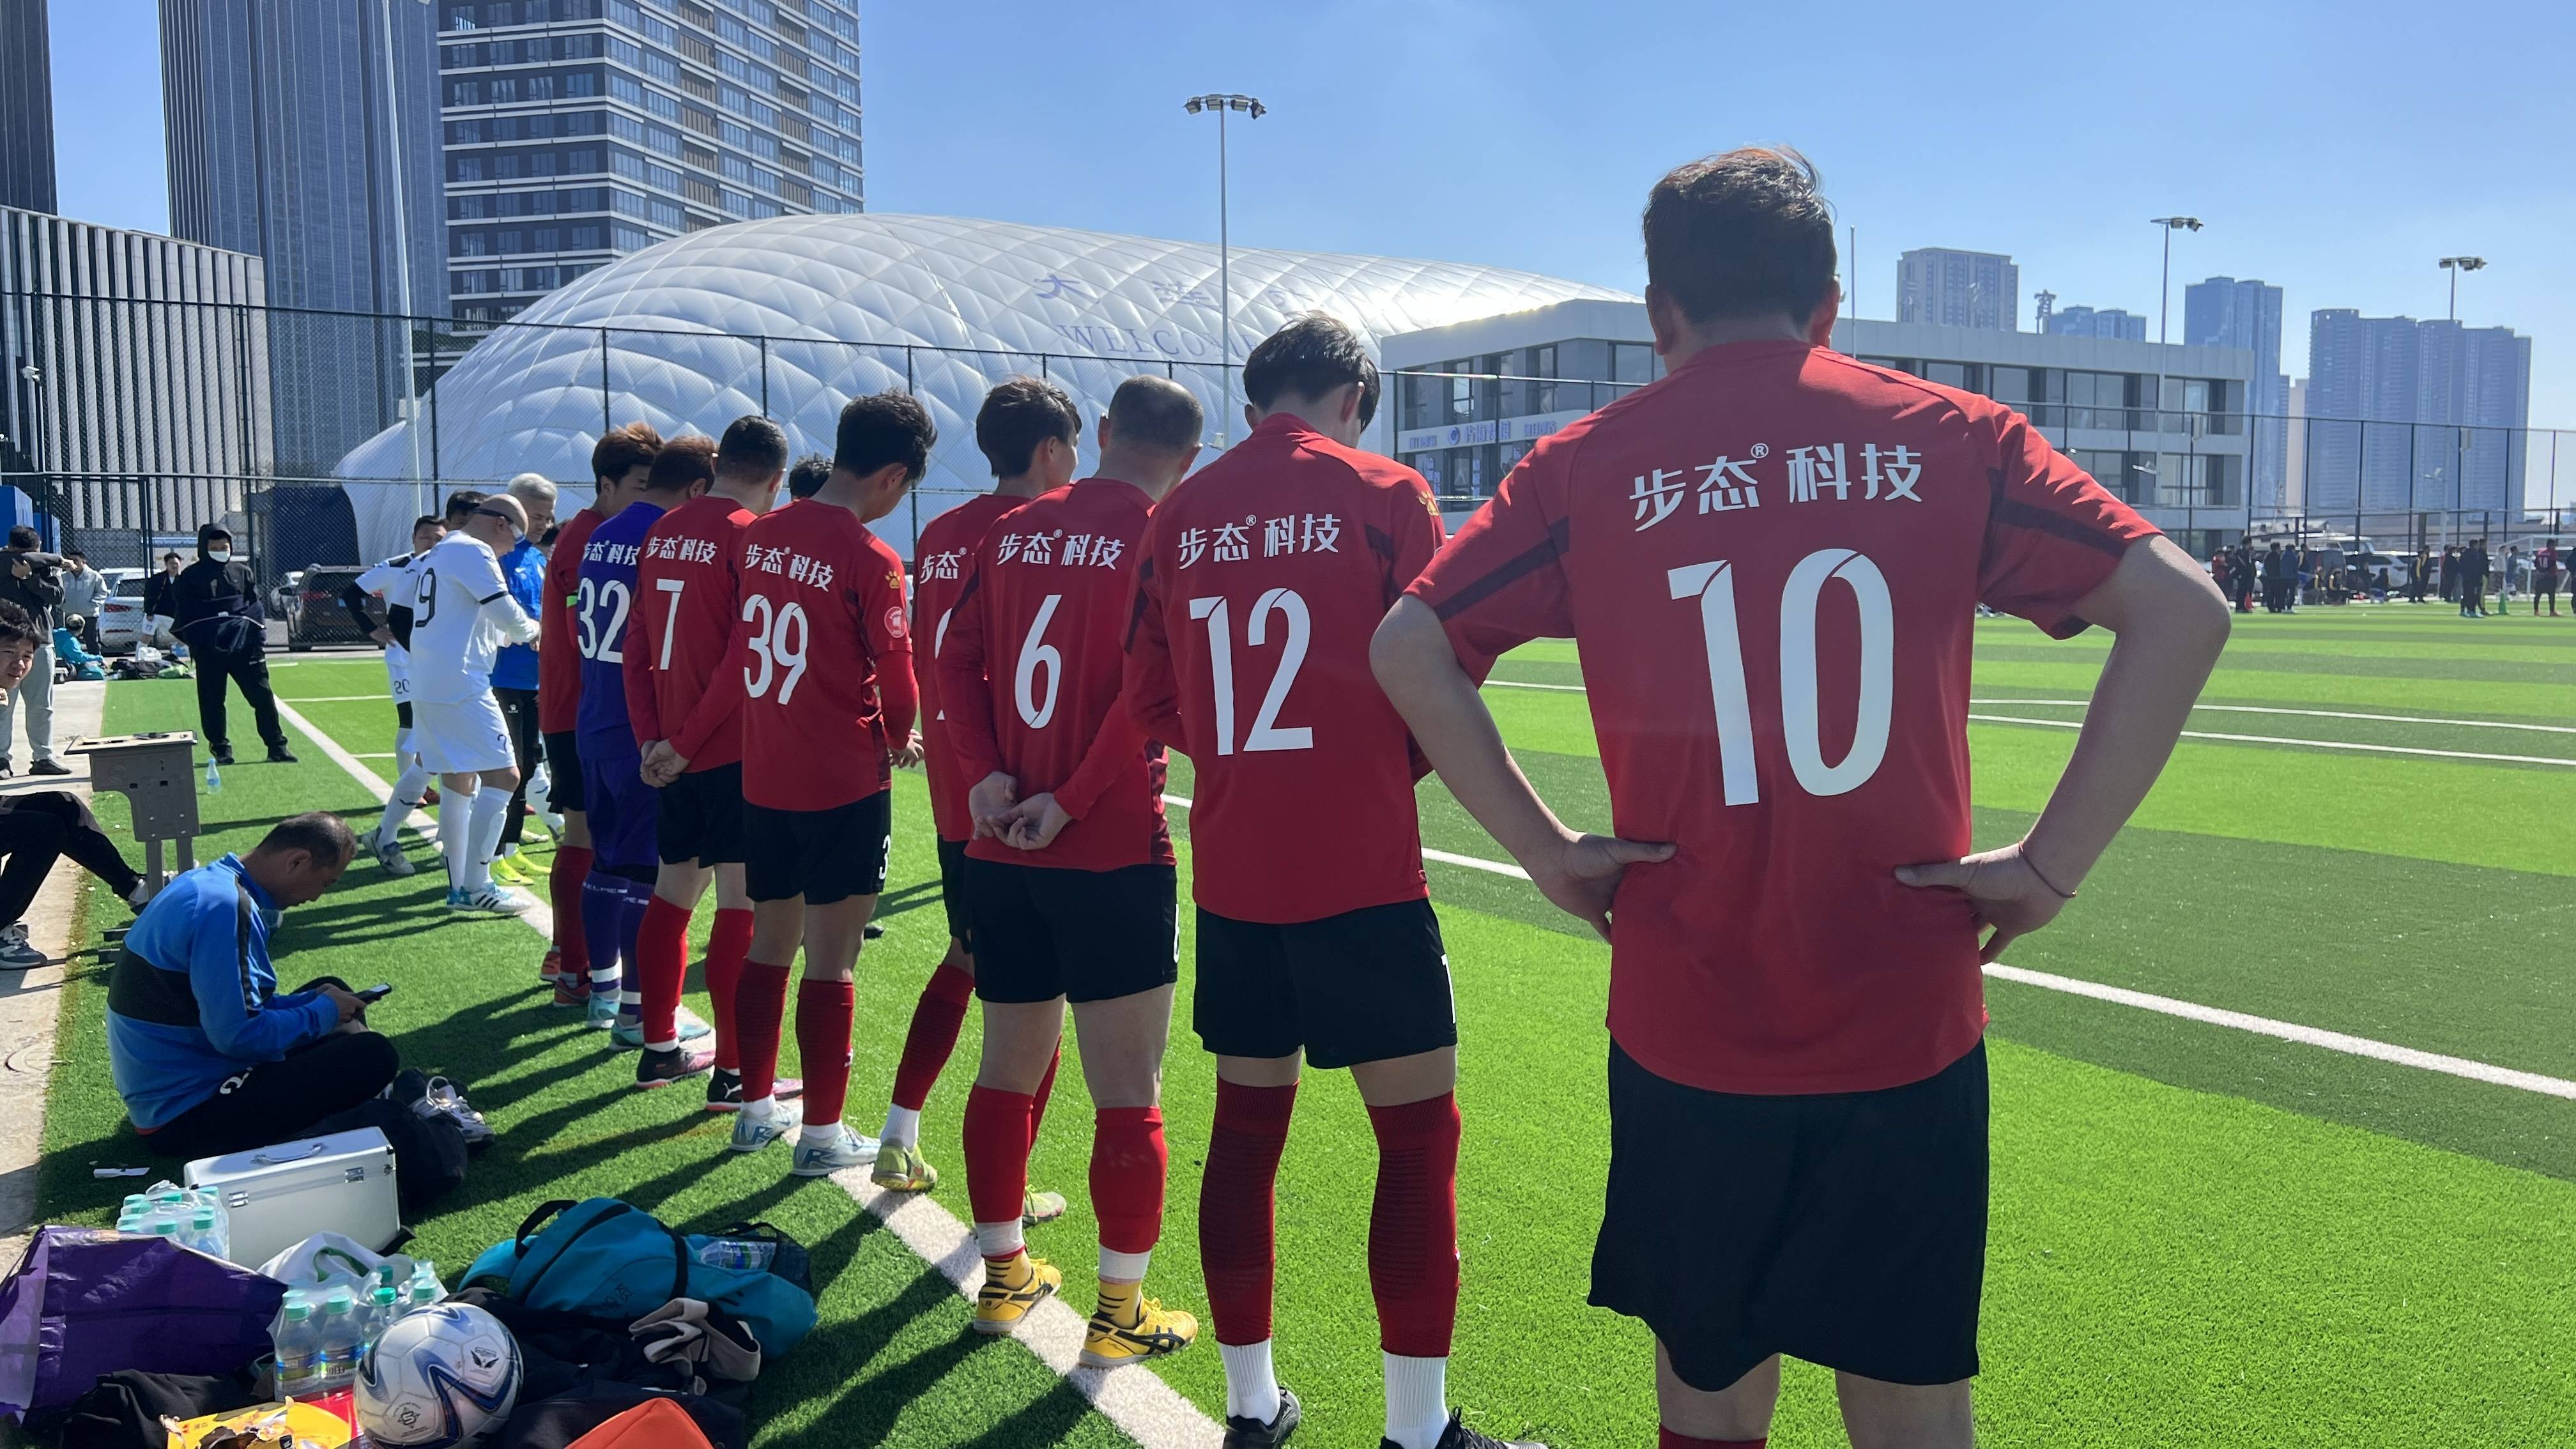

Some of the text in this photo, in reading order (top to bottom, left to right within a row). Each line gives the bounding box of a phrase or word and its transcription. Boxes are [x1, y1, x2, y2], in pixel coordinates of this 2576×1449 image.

[415, 567, 437, 627] 9
[577, 577, 631, 664] 32
[656, 578, 685, 671] 7
[742, 594, 809, 705] 39
[1015, 594, 1062, 730] 6
[1189, 587, 1314, 756] 12
[1667, 548, 1894, 806] 10
